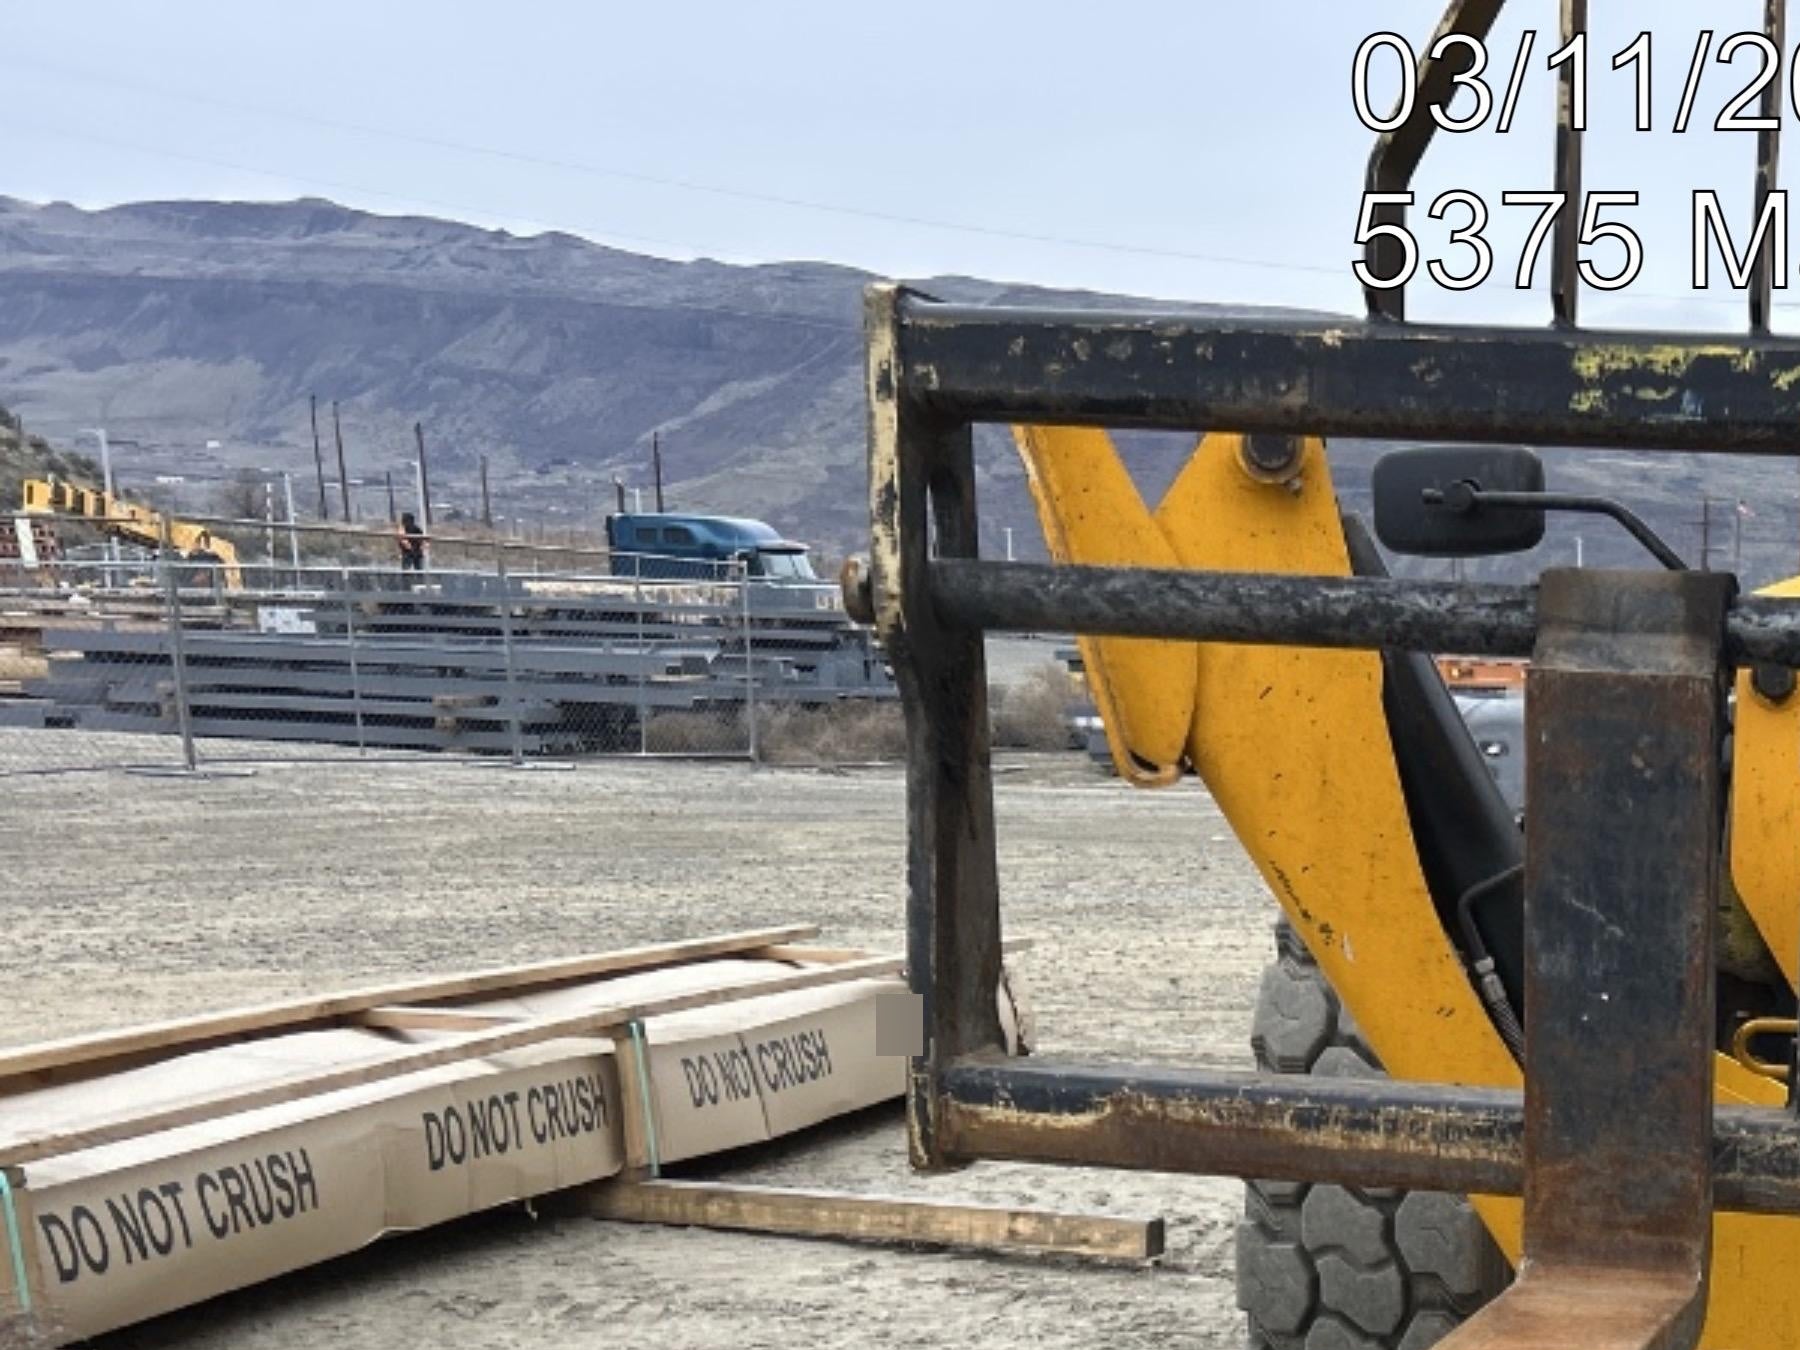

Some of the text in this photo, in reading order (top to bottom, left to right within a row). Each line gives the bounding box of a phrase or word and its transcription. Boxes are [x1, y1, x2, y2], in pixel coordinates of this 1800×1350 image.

[681, 1055, 719, 1108] DO
[755, 1028, 833, 1093] CRUSH
[422, 1073, 609, 1171] DO NOT CRUSH
[38, 1147, 319, 1283] DO NOT CRUSH
